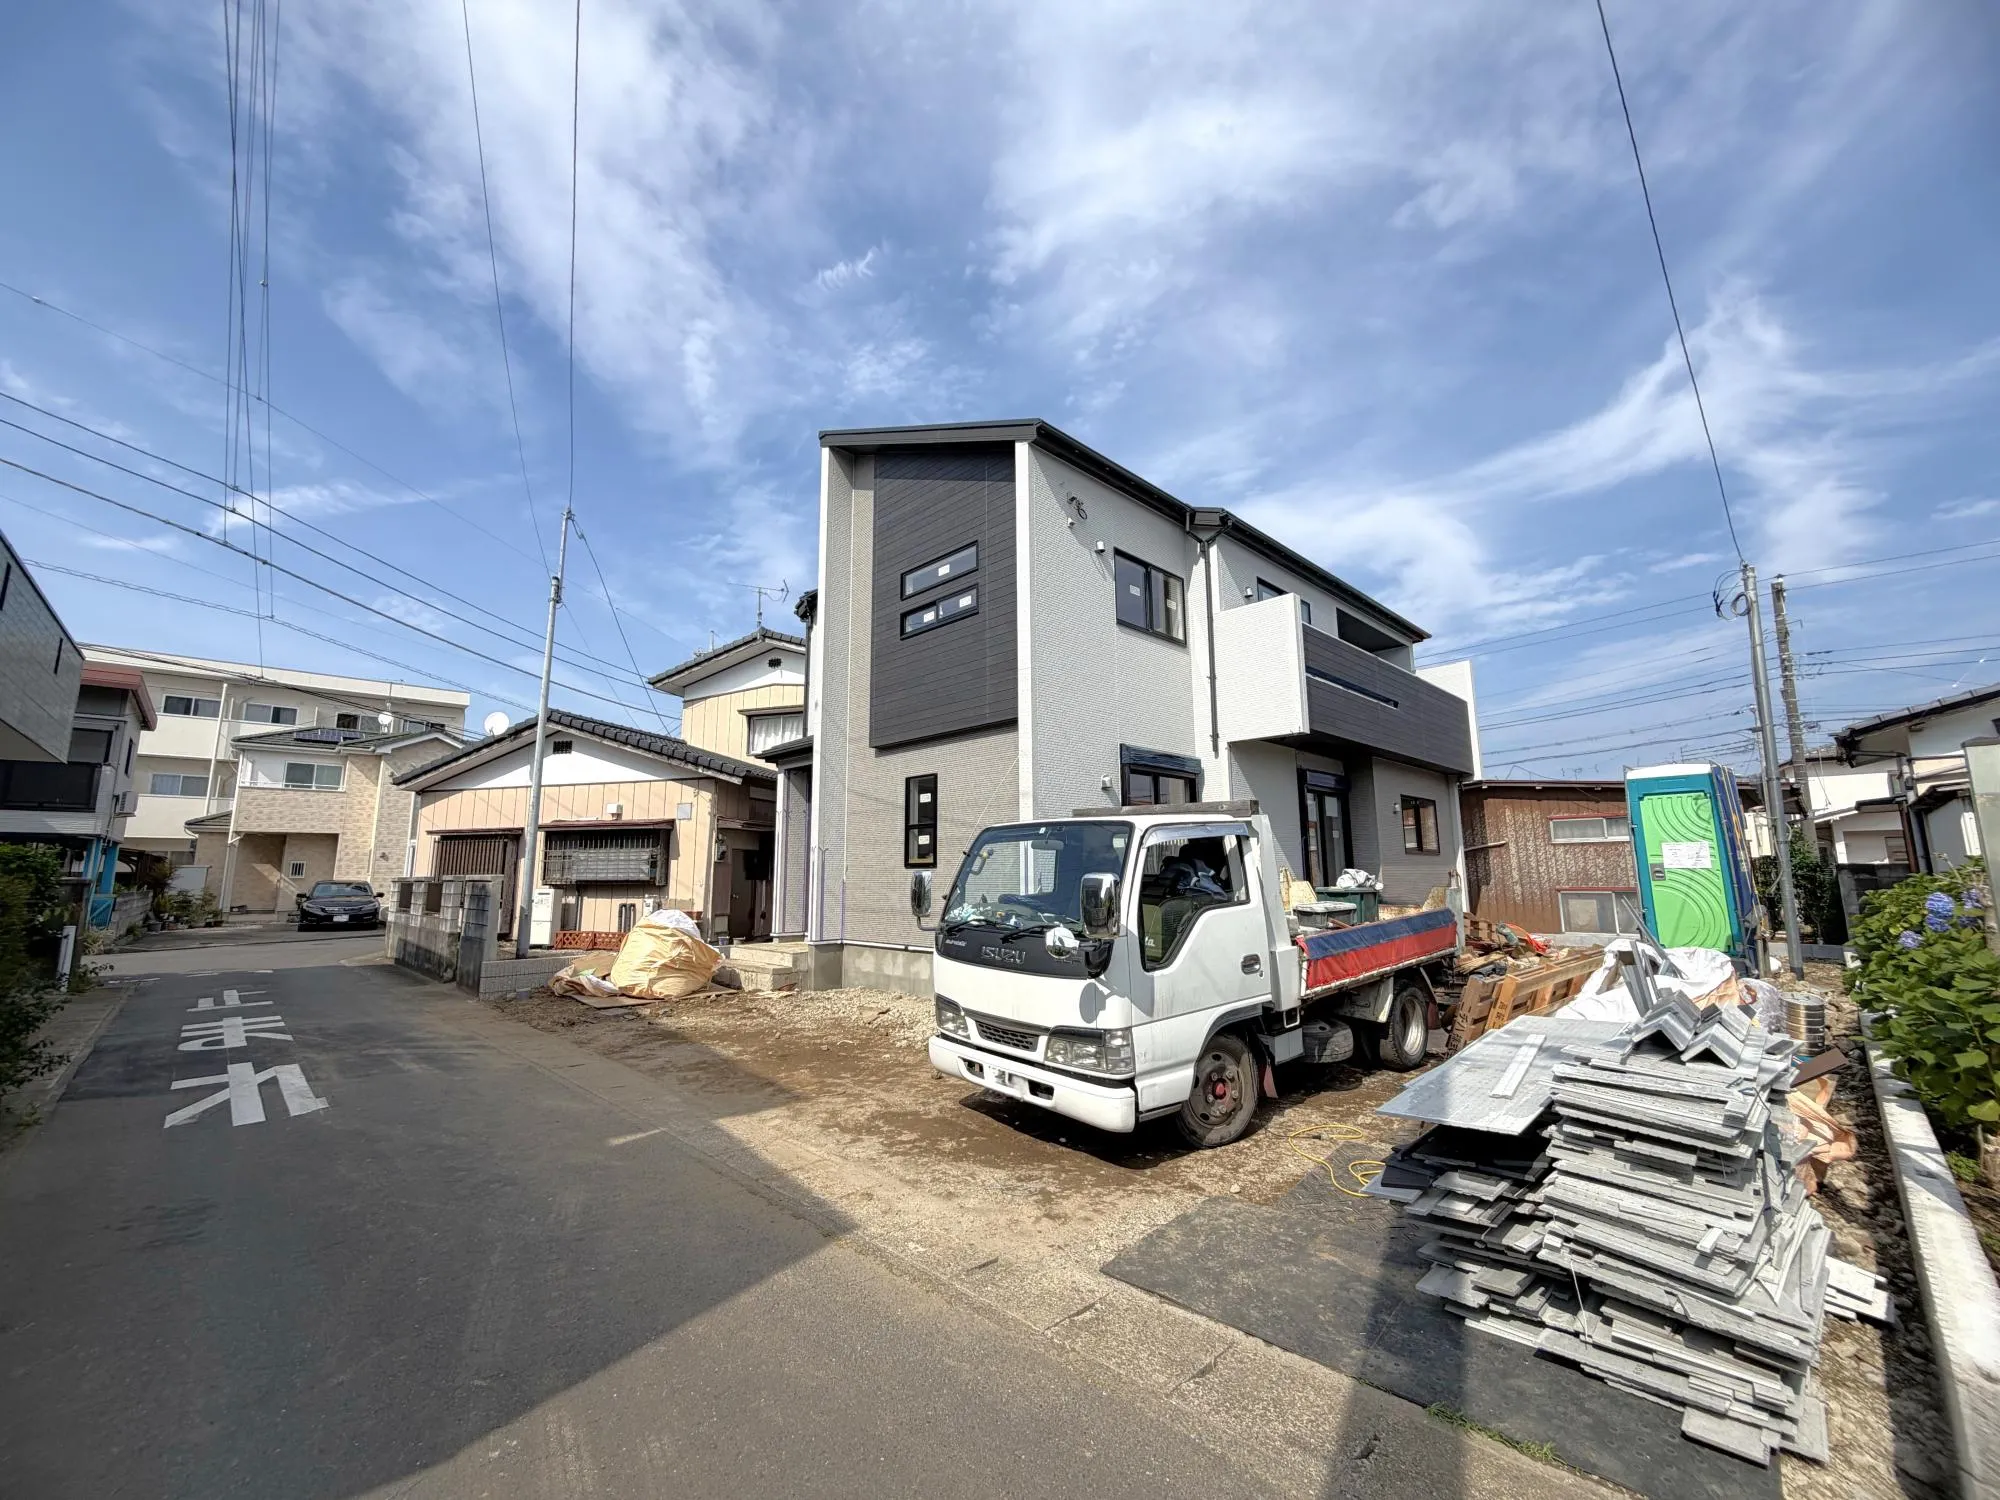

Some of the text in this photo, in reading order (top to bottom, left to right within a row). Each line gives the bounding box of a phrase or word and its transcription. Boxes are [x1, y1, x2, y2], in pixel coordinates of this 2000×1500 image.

[981, 945, 1026, 965] ISUZU
[164, 989, 330, 1129] 止まれ
